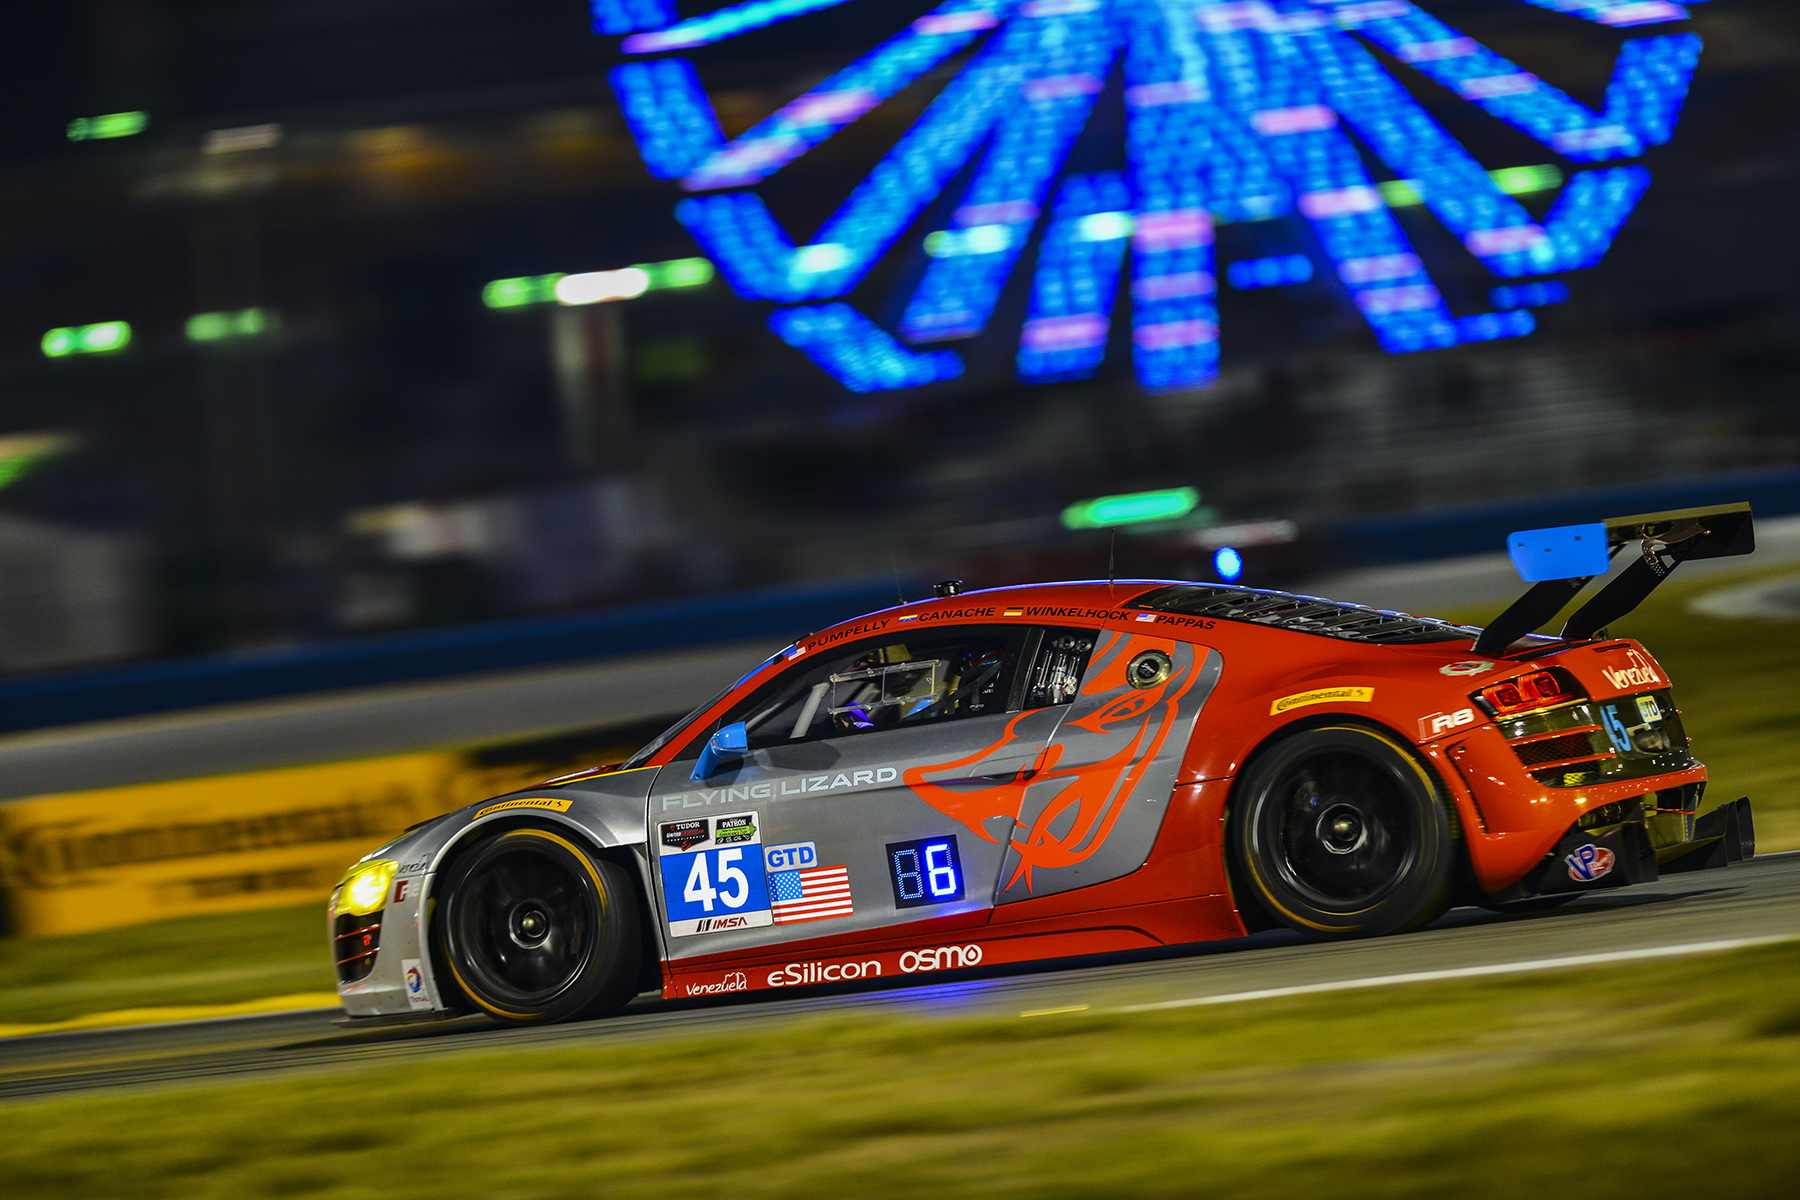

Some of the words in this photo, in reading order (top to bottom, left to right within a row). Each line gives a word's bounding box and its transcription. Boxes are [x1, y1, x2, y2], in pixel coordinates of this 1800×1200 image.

[919, 607, 996, 622] CANACHE
[1026, 606, 1131, 621] WINKELHOCK
[1155, 615, 1216, 630] PAPPAS
[808, 619, 891, 650] PUMPELLY
[1276, 689, 1353, 711] Continental
[1431, 708, 1475, 734] R8
[662, 783, 774, 811] FLYING
[781, 767, 897, 796] LIZARD
[675, 821, 700, 830] TUDOR
[767, 845, 814, 869] GTD
[683, 847, 749, 912] 45
[712, 916, 748, 930] IMSA
[686, 971, 748, 996] Venezuela
[767, 960, 881, 986] eSilicon
